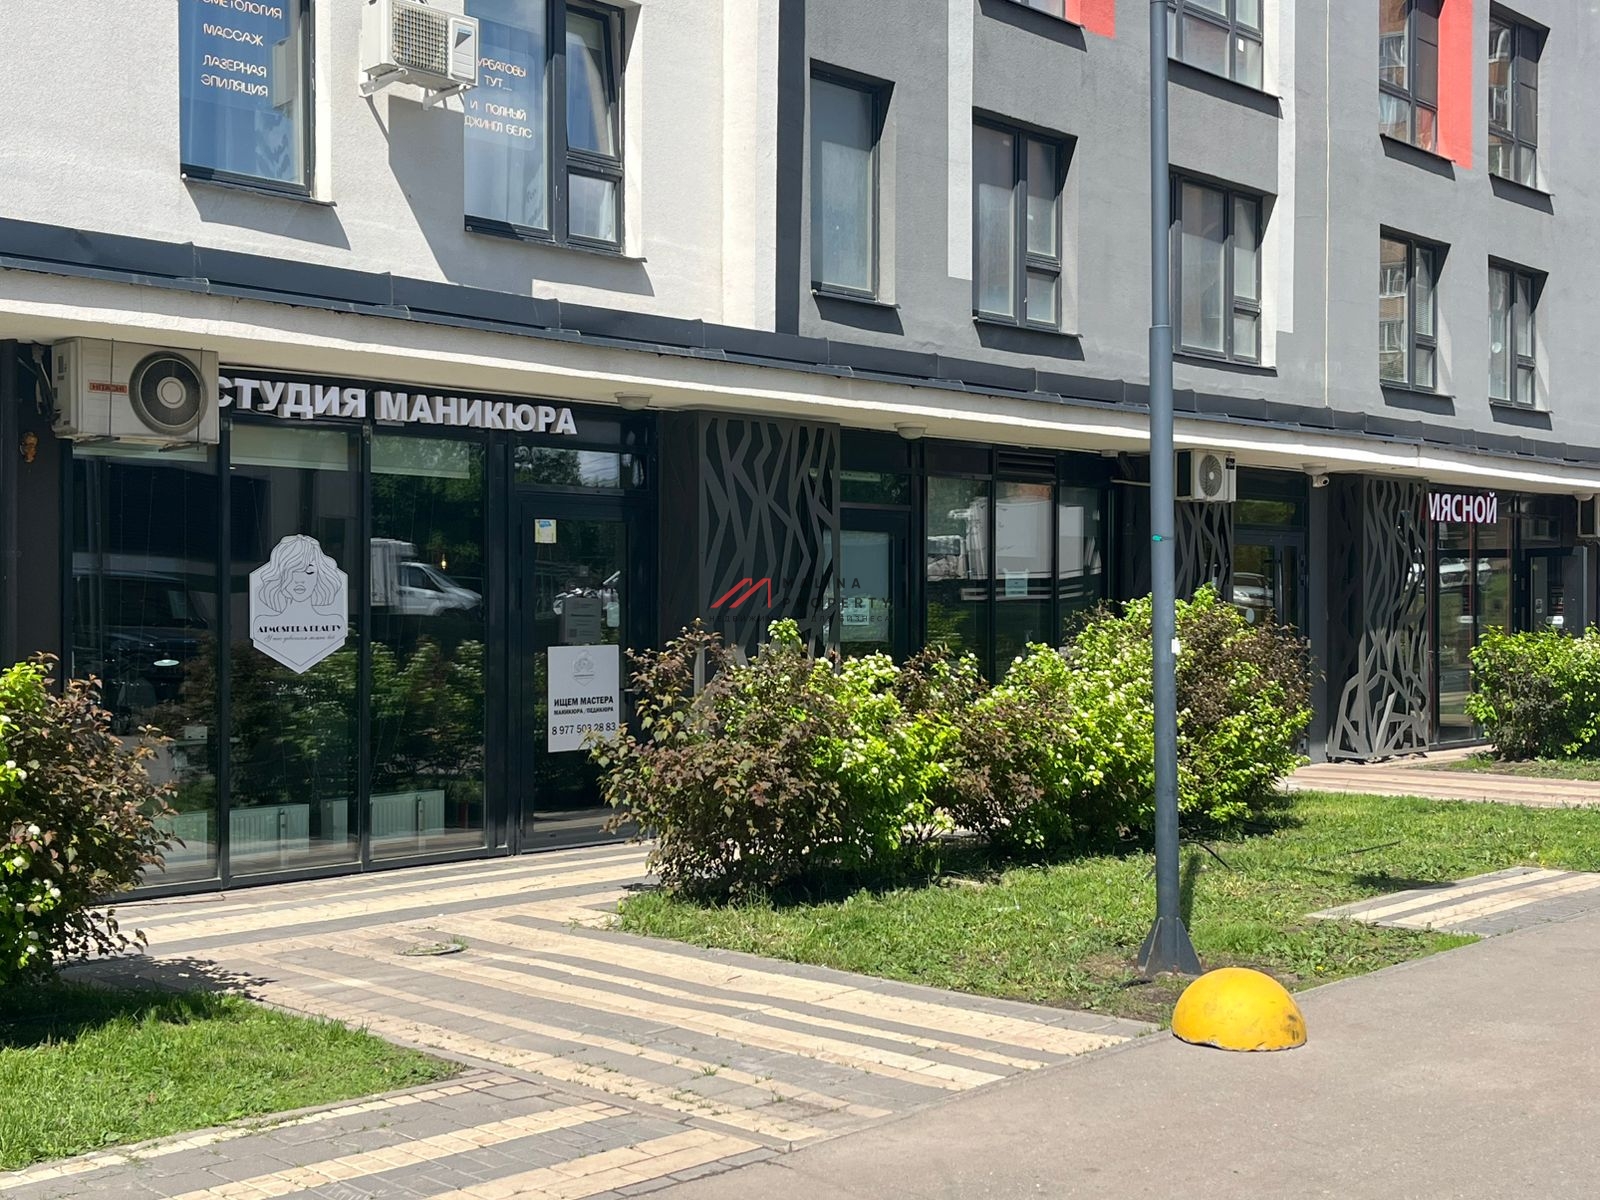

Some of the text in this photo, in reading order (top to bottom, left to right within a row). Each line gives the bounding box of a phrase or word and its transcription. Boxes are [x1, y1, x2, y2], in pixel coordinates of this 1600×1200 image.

[203, 23, 264, 47] МАССАЖ
[203, 54, 267, 78] ЛАЗЕРНАЯ
[201, 74, 268, 97] ЭПИЛЯЦИЯ
[470, 100, 527, 121] И ПОЛНЫЙ
[506, 124, 532, 139] БЕЛС
[375, 391, 577, 435] МАНИКЮРА
[554, 696, 614, 707] ИЩЕМ МАСТЕРА
[551, 726, 558, 735] 8
[559, 725, 574, 735] 977
[576, 724, 592, 733] 503
[605, 722, 616, 731] 83
